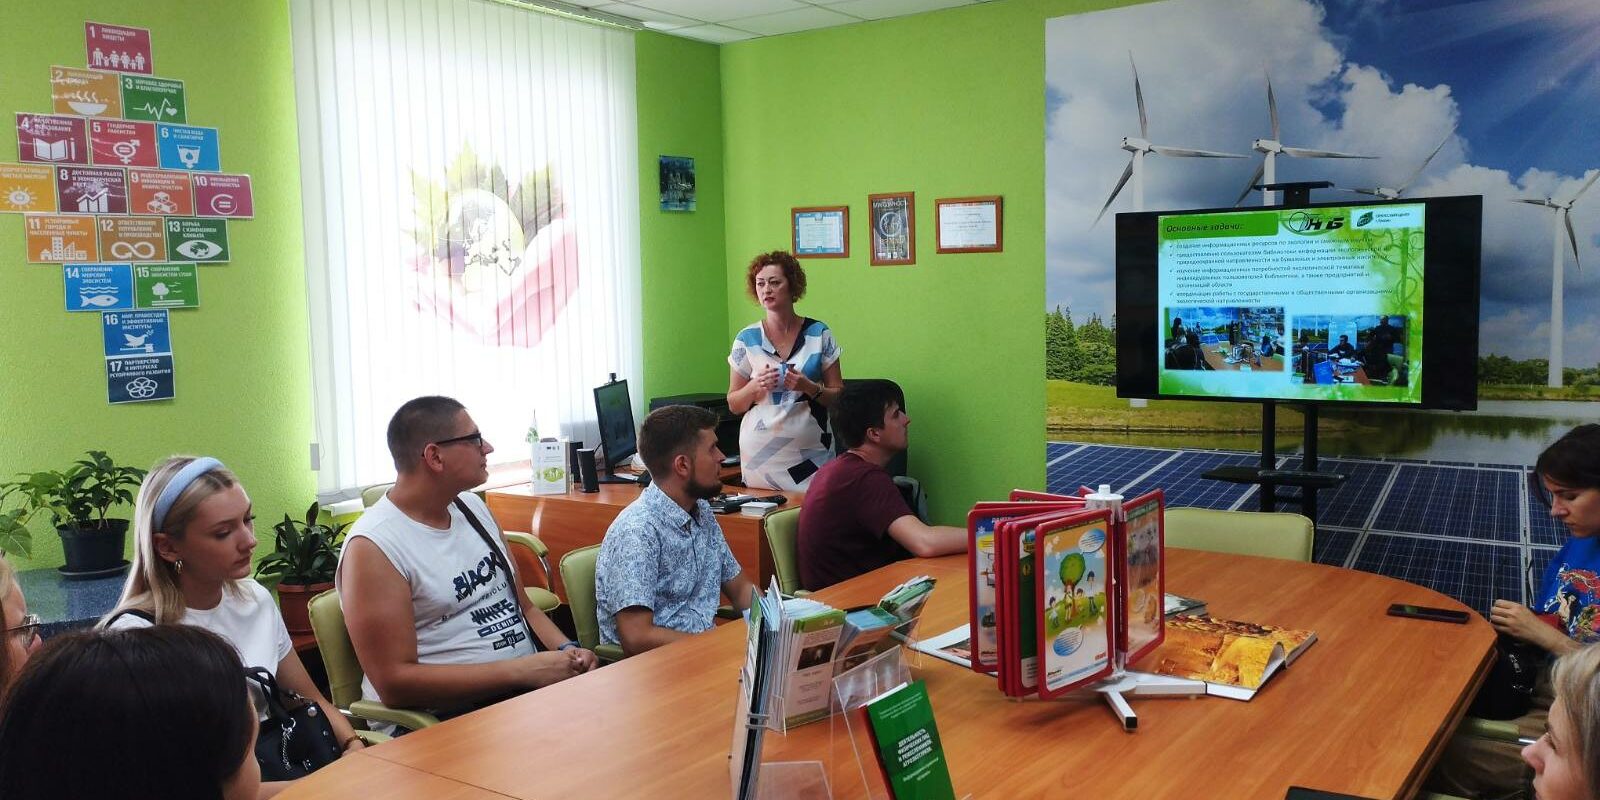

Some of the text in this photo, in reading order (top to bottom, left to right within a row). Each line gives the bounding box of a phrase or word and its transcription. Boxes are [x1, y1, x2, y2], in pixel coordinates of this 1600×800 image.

[89, 25, 96, 38] 1
[55, 70, 64, 80] 2
[125, 78, 133, 90] 3
[21, 117, 30, 129] 4
[93, 121, 101, 132] 5
[161, 128, 169, 139] 6
[60, 169, 68, 181] 8
[131, 171, 139, 183] 9
[194, 175, 208, 188] 10
[29, 218, 40, 230] 11
[101, 219, 114, 232] 12
[168, 221, 180, 232] 13
[1166, 224, 1208, 233] Основные
[66, 267, 80, 279] 14
[137, 266, 149, 278] 15
[104, 314, 119, 325] 16
[110, 360, 122, 372] 17
[453, 552, 505, 603] BLACK
[470, 598, 515, 625] WHITE
[491, 618, 515, 632] DENIM
